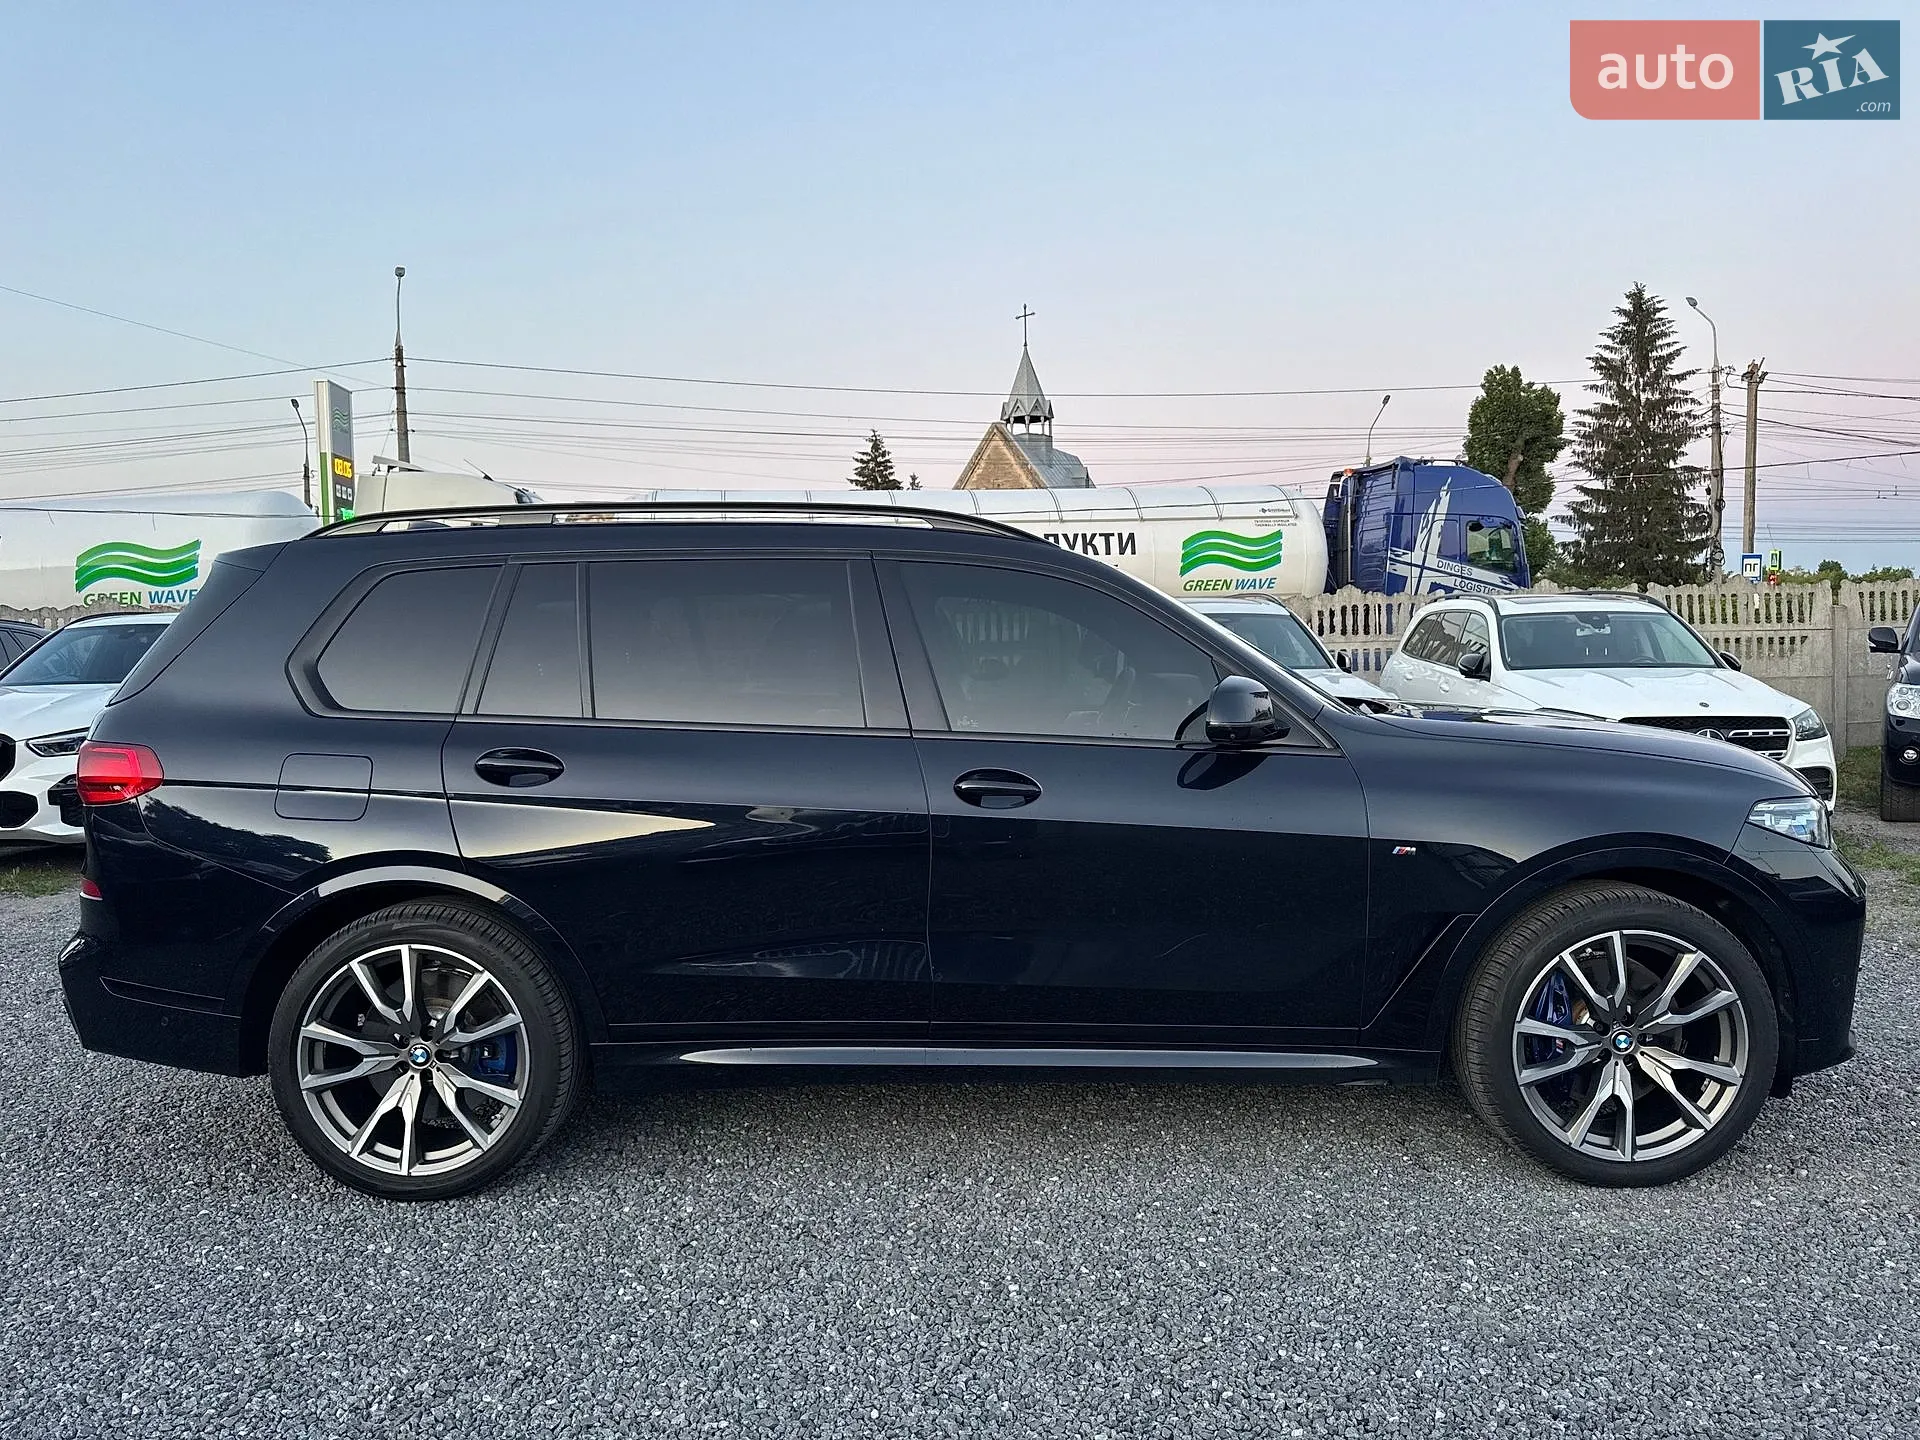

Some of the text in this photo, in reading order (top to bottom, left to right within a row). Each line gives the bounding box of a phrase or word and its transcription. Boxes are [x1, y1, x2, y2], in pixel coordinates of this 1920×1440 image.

[1436, 560, 1473, 577] DINGES
[1183, 577, 1277, 592] GREEN WAVE
